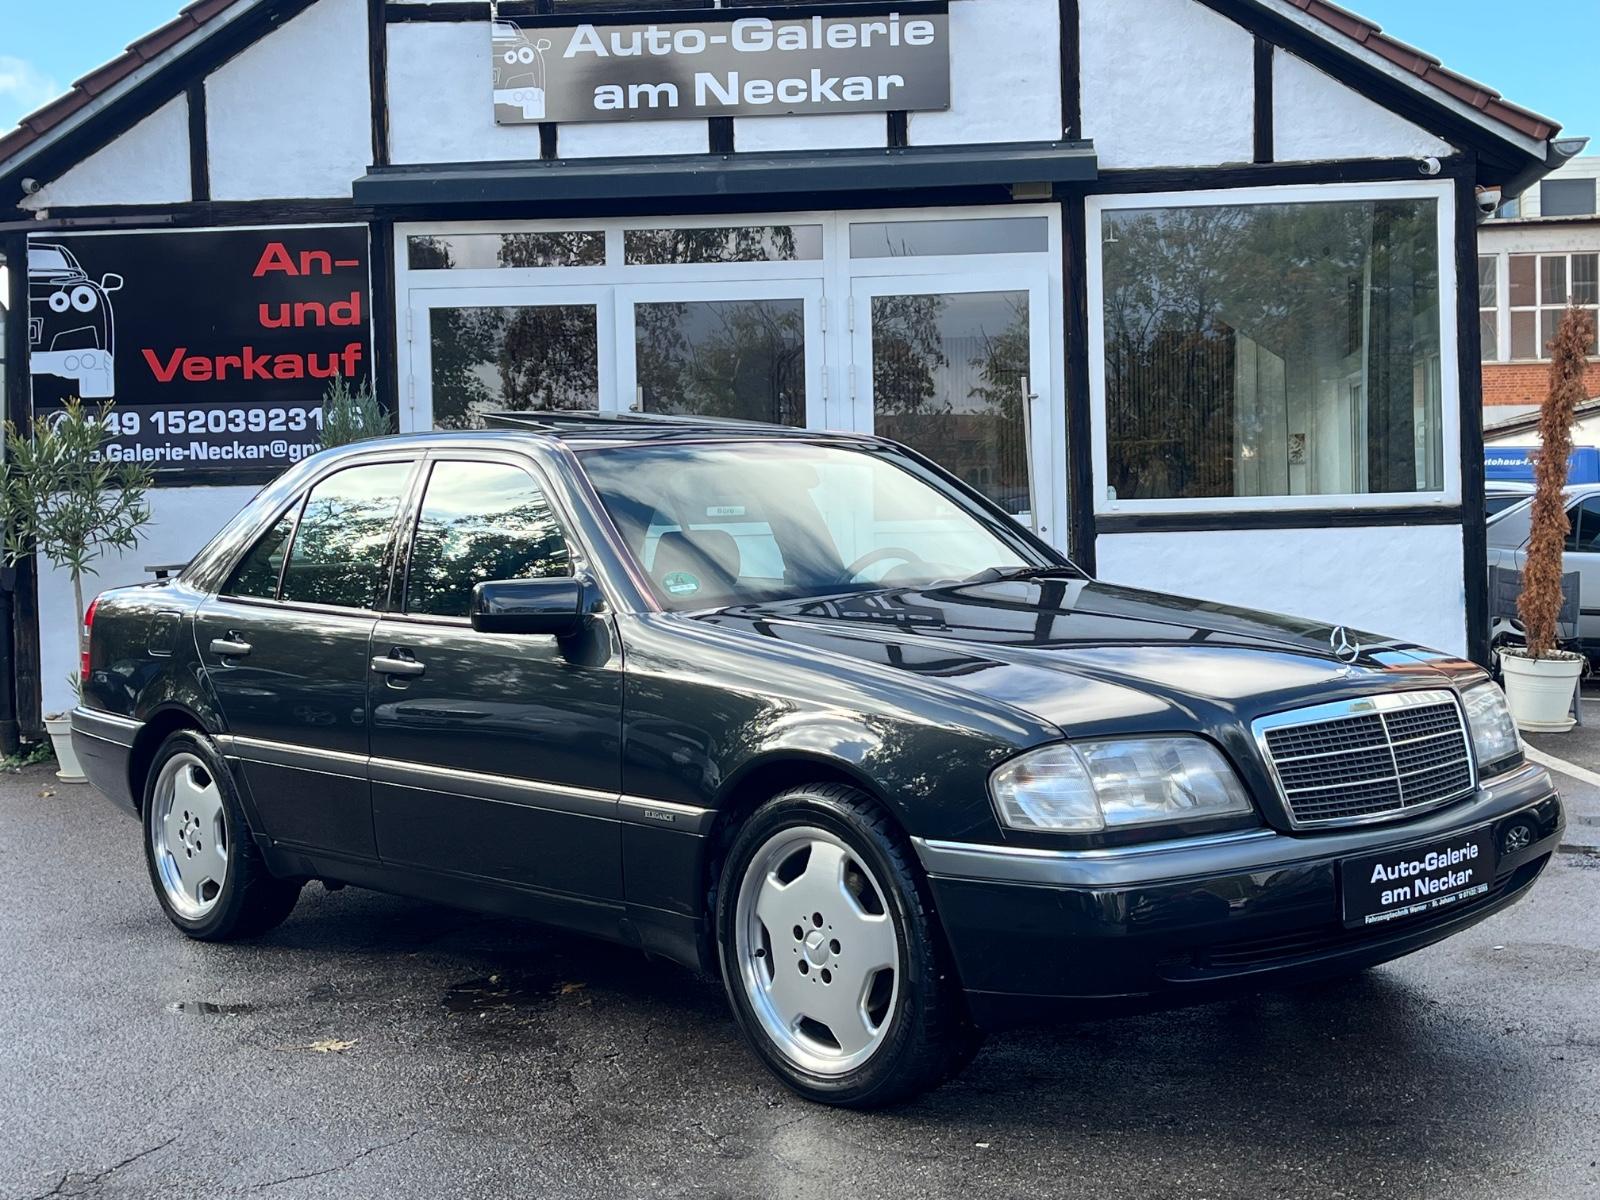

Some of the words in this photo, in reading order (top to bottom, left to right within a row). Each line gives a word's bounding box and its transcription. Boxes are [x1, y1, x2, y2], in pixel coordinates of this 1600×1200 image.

[563, 13, 935, 58] Auto-Galerie
[593, 81, 679, 110] am
[694, 68, 905, 106] Neckar
[252, 242, 360, 277] An-
[259, 291, 361, 328] und
[141, 343, 362, 382] Verkauf
[1370, 842, 1478, 883] Auto-Galerie
[1381, 886, 1411, 905] am
[1414, 868, 1472, 897] Neckar
